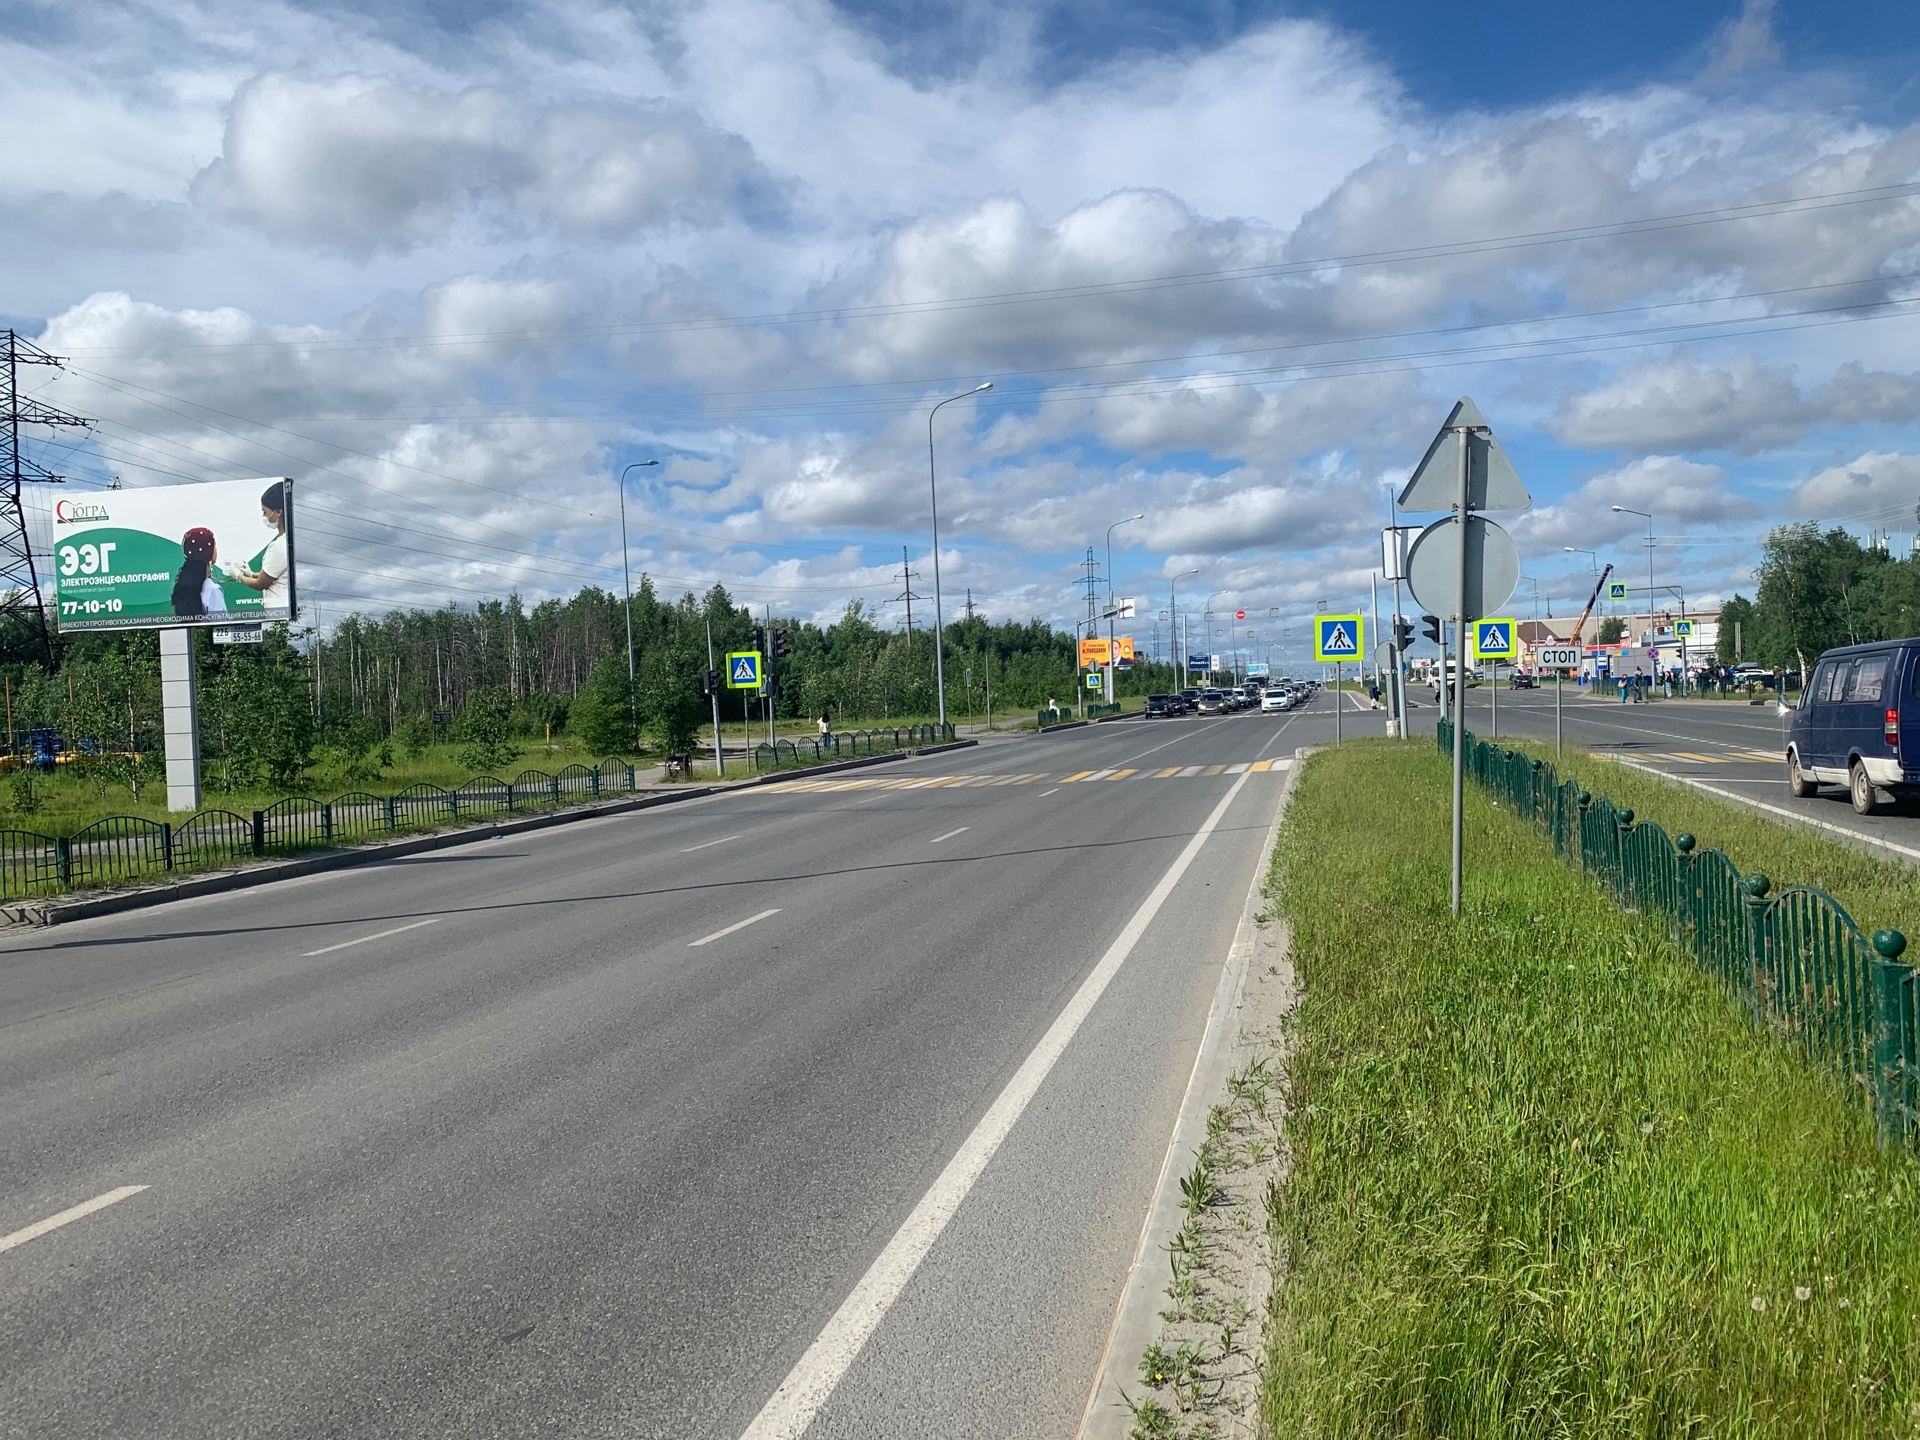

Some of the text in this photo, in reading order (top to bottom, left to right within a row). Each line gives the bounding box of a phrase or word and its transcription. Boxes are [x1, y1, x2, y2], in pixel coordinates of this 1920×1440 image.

[72, 505, 107, 518] ЮГРА
[59, 542, 117, 576] ЭЭГ
[61, 572, 170, 587] ЭЛЕКТРОЭНЦЕФАЛОГРАФИЯ
[61, 598, 123, 615] 77-10-10
[90, 617, 151, 627] ПРОТИВОПОКАЗАНИЯ
[152, 614, 194, 624] НЕОБХОДИМА
[194, 612, 241, 621] КОНСУЛЬТАЦИЯ
[242, 610, 287, 619] СПЕЦИАЛИСТА
[1542, 650, 1576, 664] СТОП
